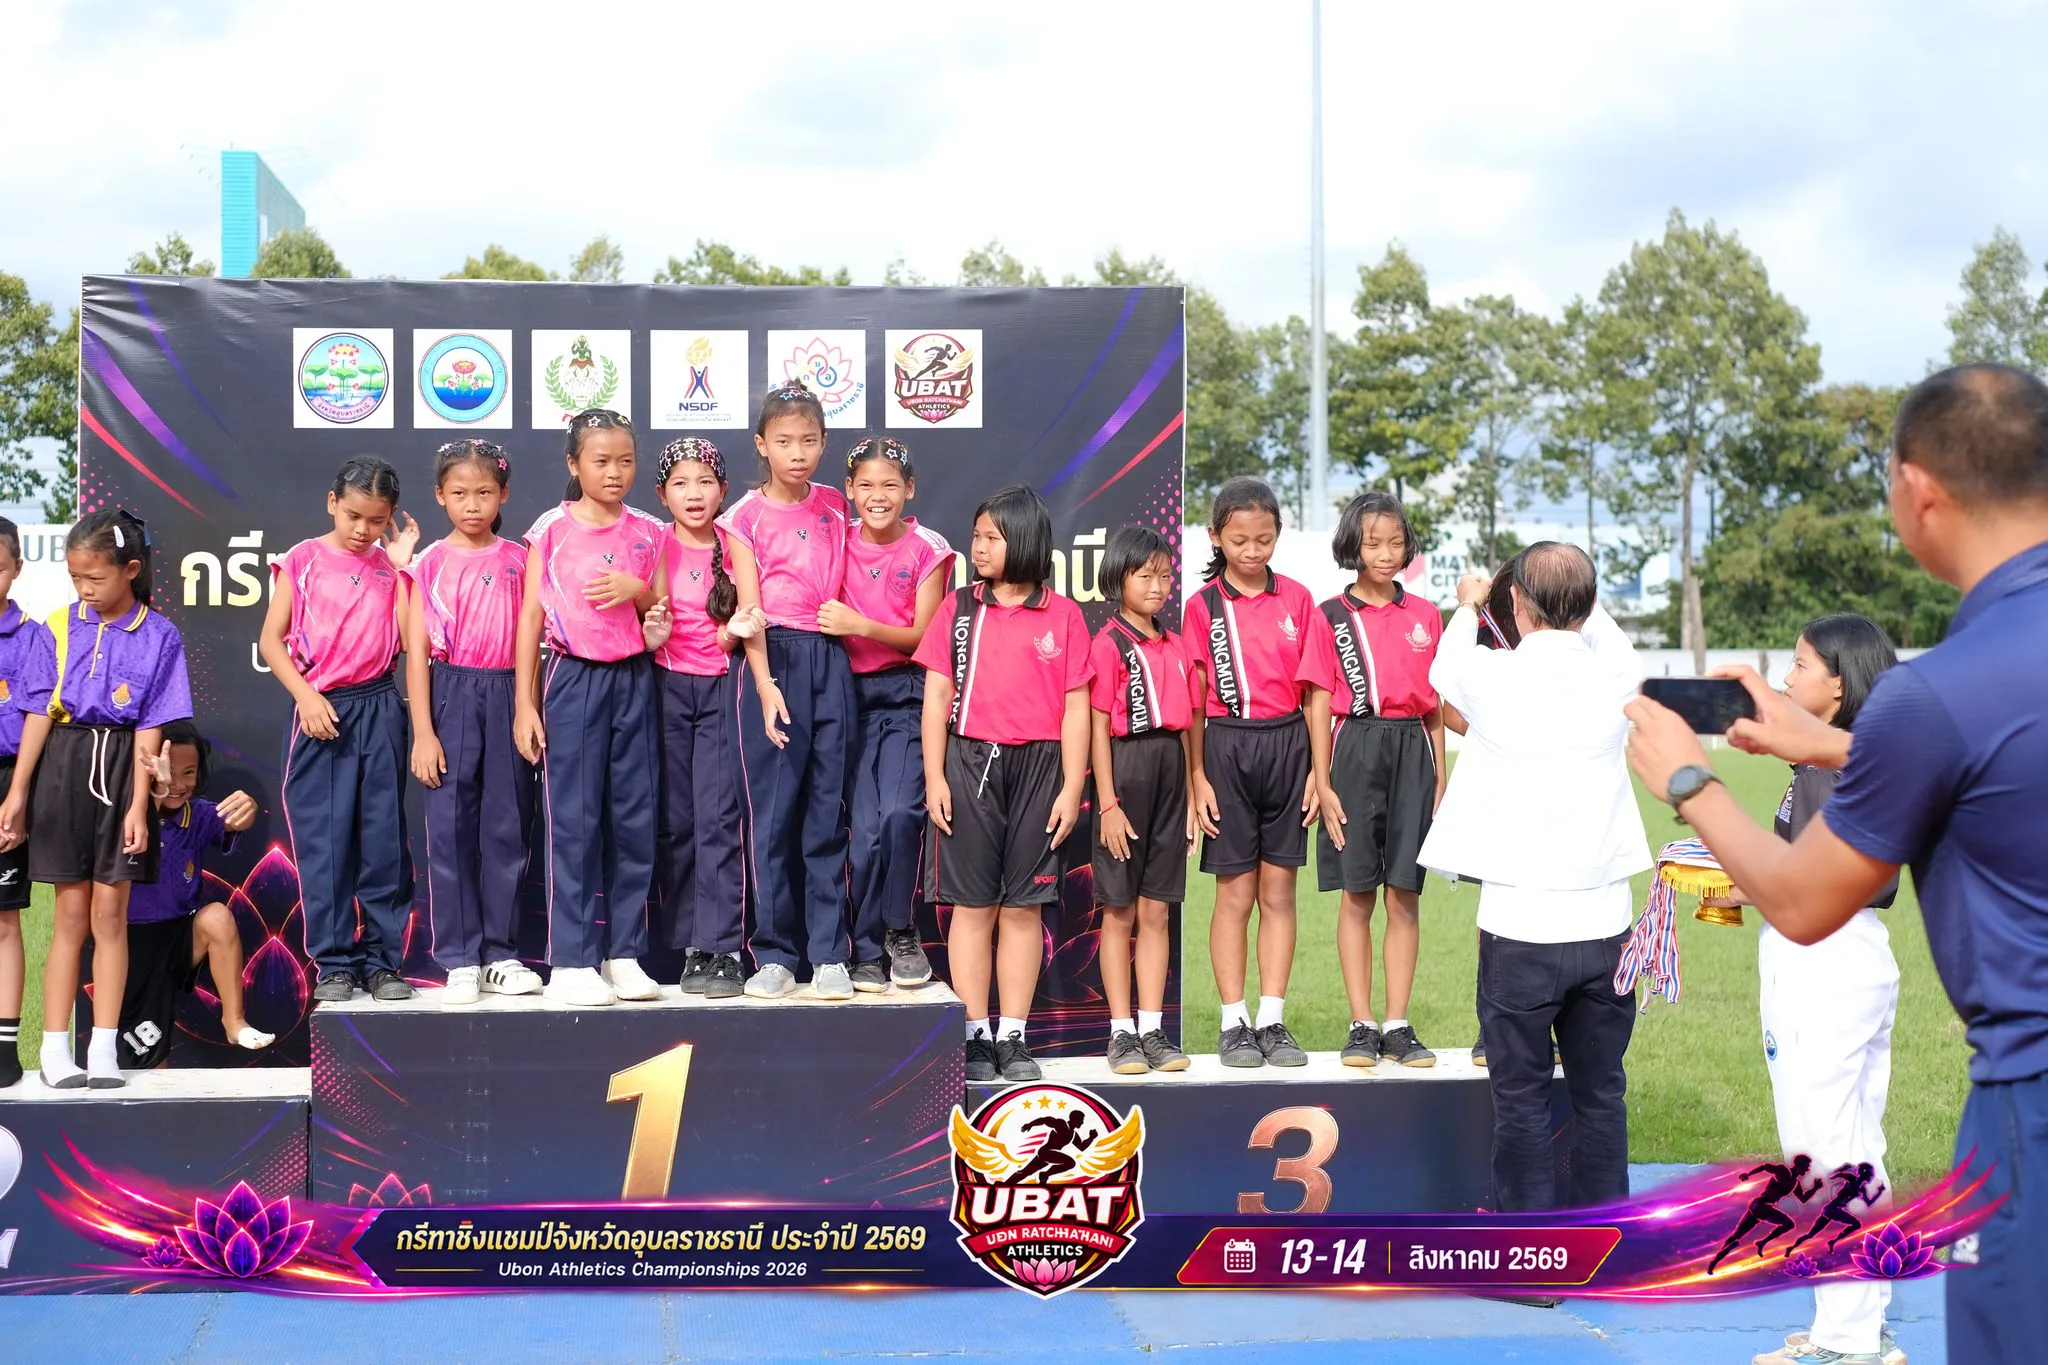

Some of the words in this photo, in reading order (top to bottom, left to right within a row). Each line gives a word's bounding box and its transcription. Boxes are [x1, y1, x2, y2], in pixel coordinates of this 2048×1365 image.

[678, 402, 719, 411] NSDF
[900, 380, 968, 397] UBAT
[1431, 573, 1461, 588] CIT
[1334, 622, 1369, 717] NONGMUAN
[1125, 649, 1149, 733] NONGMUA
[1033, 875, 1058, 885] SPORT
[123, 1020, 162, 1056] 18
[606, 1043, 694, 1201] 1
[1237, 1105, 1340, 1214] 3
